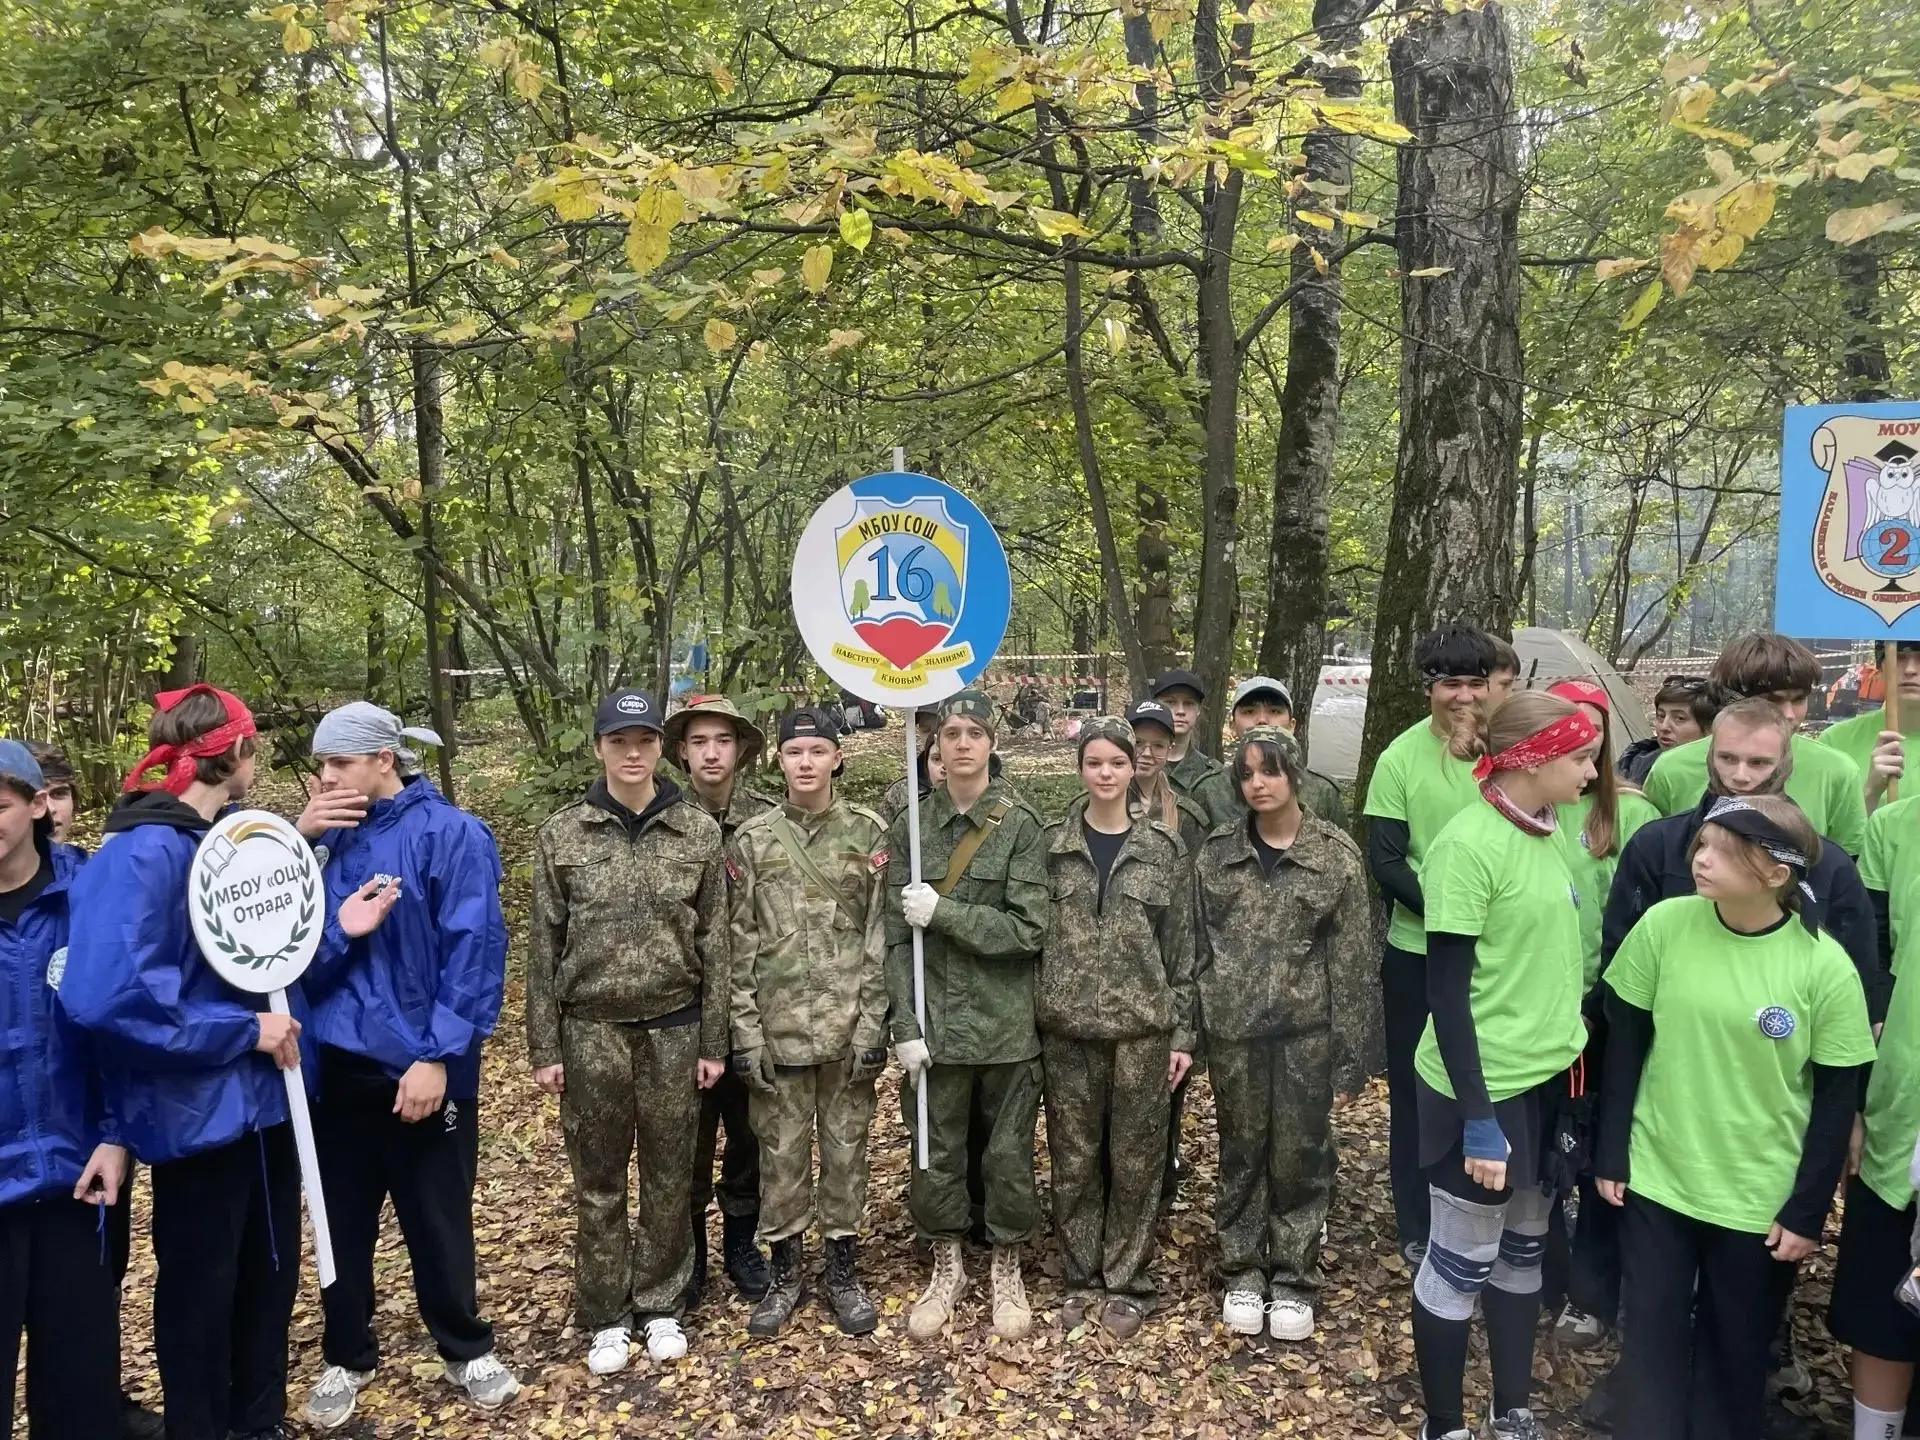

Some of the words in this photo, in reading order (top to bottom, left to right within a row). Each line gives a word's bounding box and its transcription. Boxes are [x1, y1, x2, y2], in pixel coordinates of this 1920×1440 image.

[1877, 422, 1920, 436] МОУ
[858, 514, 899, 540] МБОУ
[905, 515, 938, 540] СОШ
[1878, 527, 1910, 565] 2
[868, 545, 933, 602] 16
[835, 647, 880, 665] НАВСТРЕЧУ
[925, 650, 966, 666] ЗНАНИЯМ!
[881, 673, 888, 681] К
[888, 674, 922, 685] НОВЫМ
[214, 875, 261, 907] МБОУ
[234, 892, 293, 923] Отрада
[1760, 1007, 1794, 1028] ОРИЕНТИР
